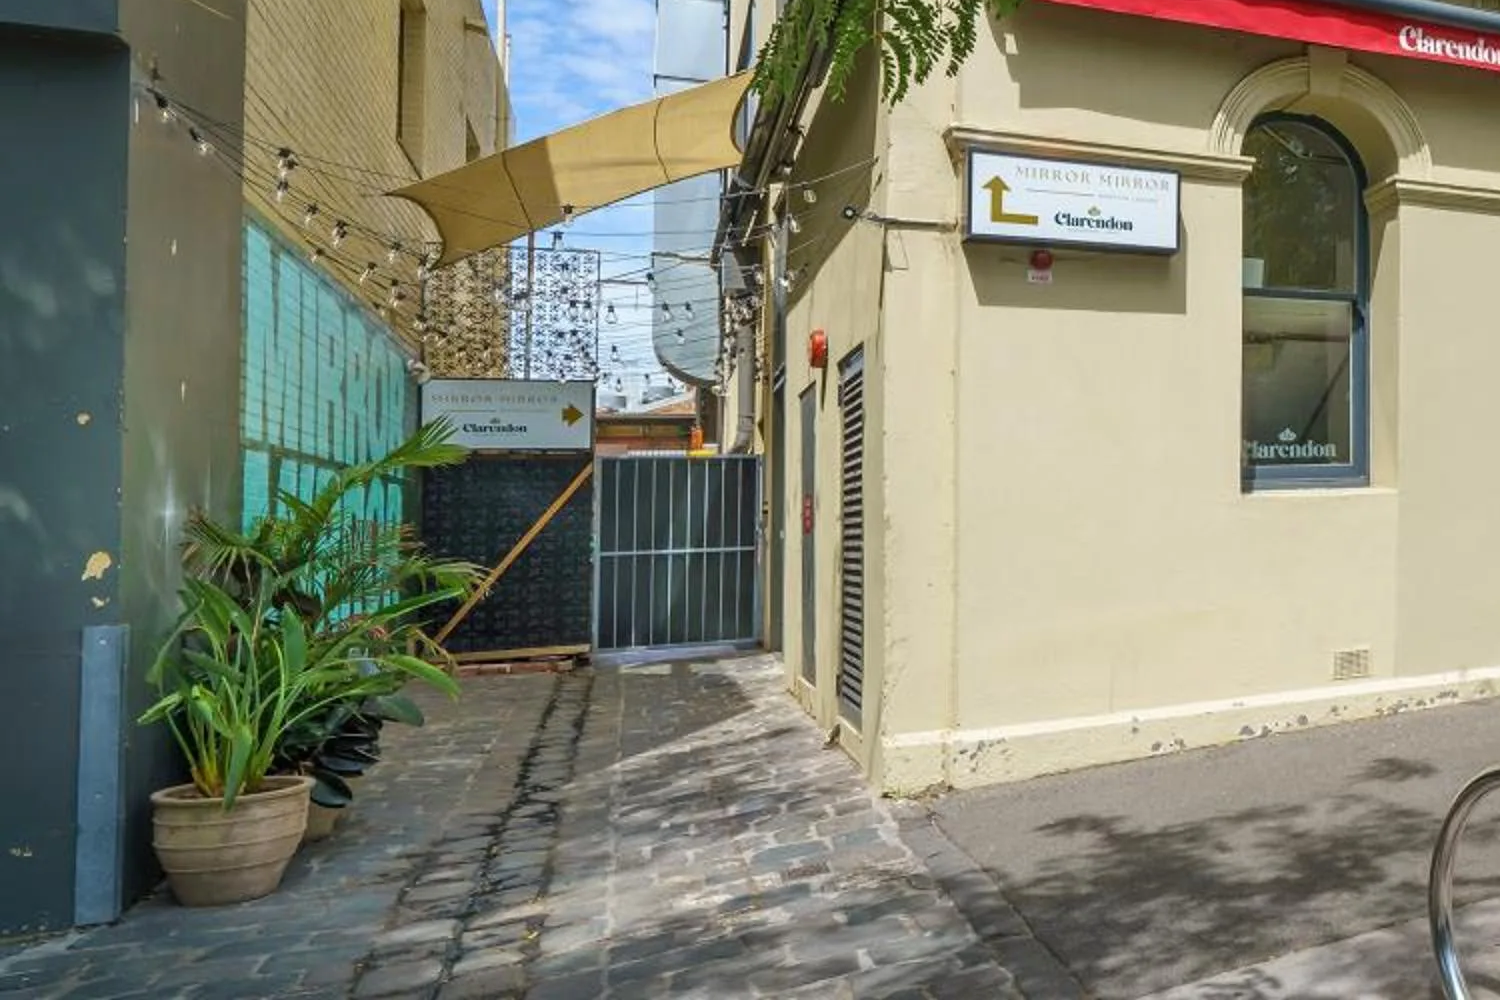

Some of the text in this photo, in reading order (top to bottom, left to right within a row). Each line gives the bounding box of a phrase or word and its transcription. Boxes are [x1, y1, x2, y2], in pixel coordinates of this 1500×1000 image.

[1015, 165, 1170, 192] MIRROR MIRROR
[1054, 211, 1133, 231] Clarendon
[462, 422, 528, 433] Clarendon
